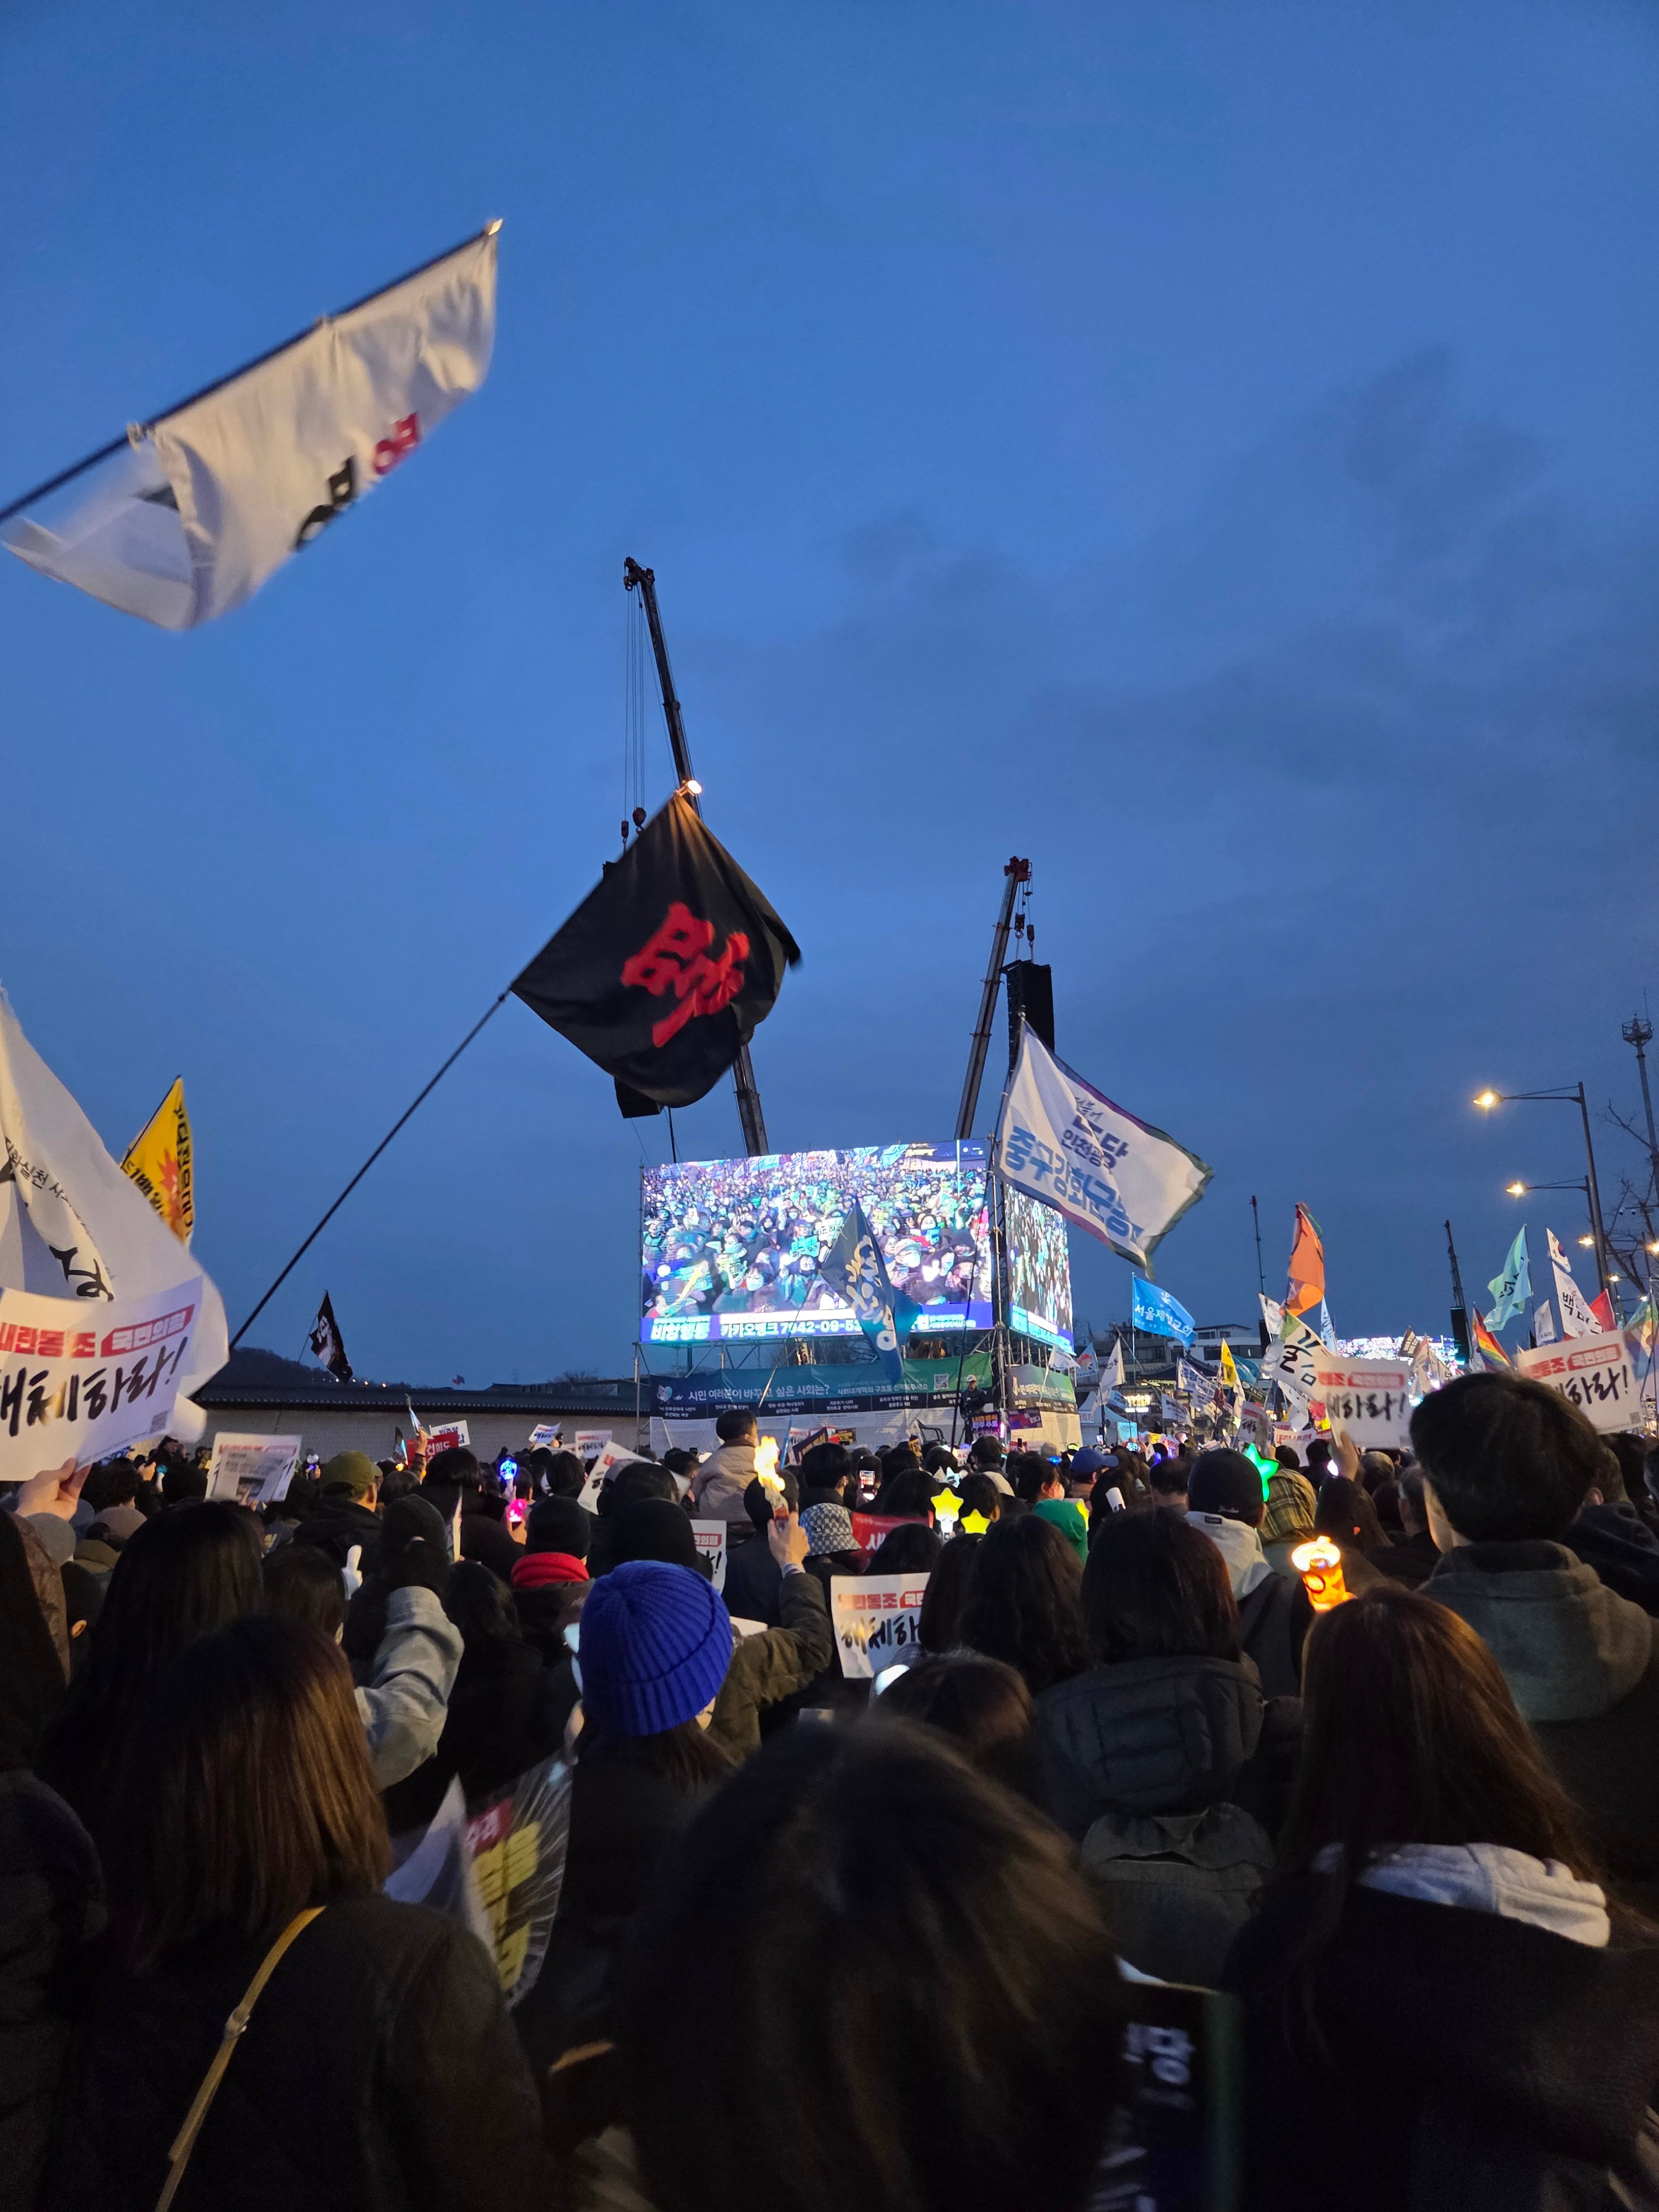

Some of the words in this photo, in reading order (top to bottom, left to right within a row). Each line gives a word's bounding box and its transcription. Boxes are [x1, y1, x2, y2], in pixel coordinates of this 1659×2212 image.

[721, 1322, 778, 1338] 카카오뱅크
[781, 1318, 863, 1334] 7942-09-53
[1134, 1304, 1193, 1337] 서울제일교회
[688, 1390, 707, 1401] 시민
[708, 1388, 742, 1400] 여러분이
[775, 1385, 795, 1397] 싶은
[796, 1384, 830, 1395] 사회는?
[1556, 1365, 1627, 1405] 하라!
[841, 1614, 920, 1655] 해체하
